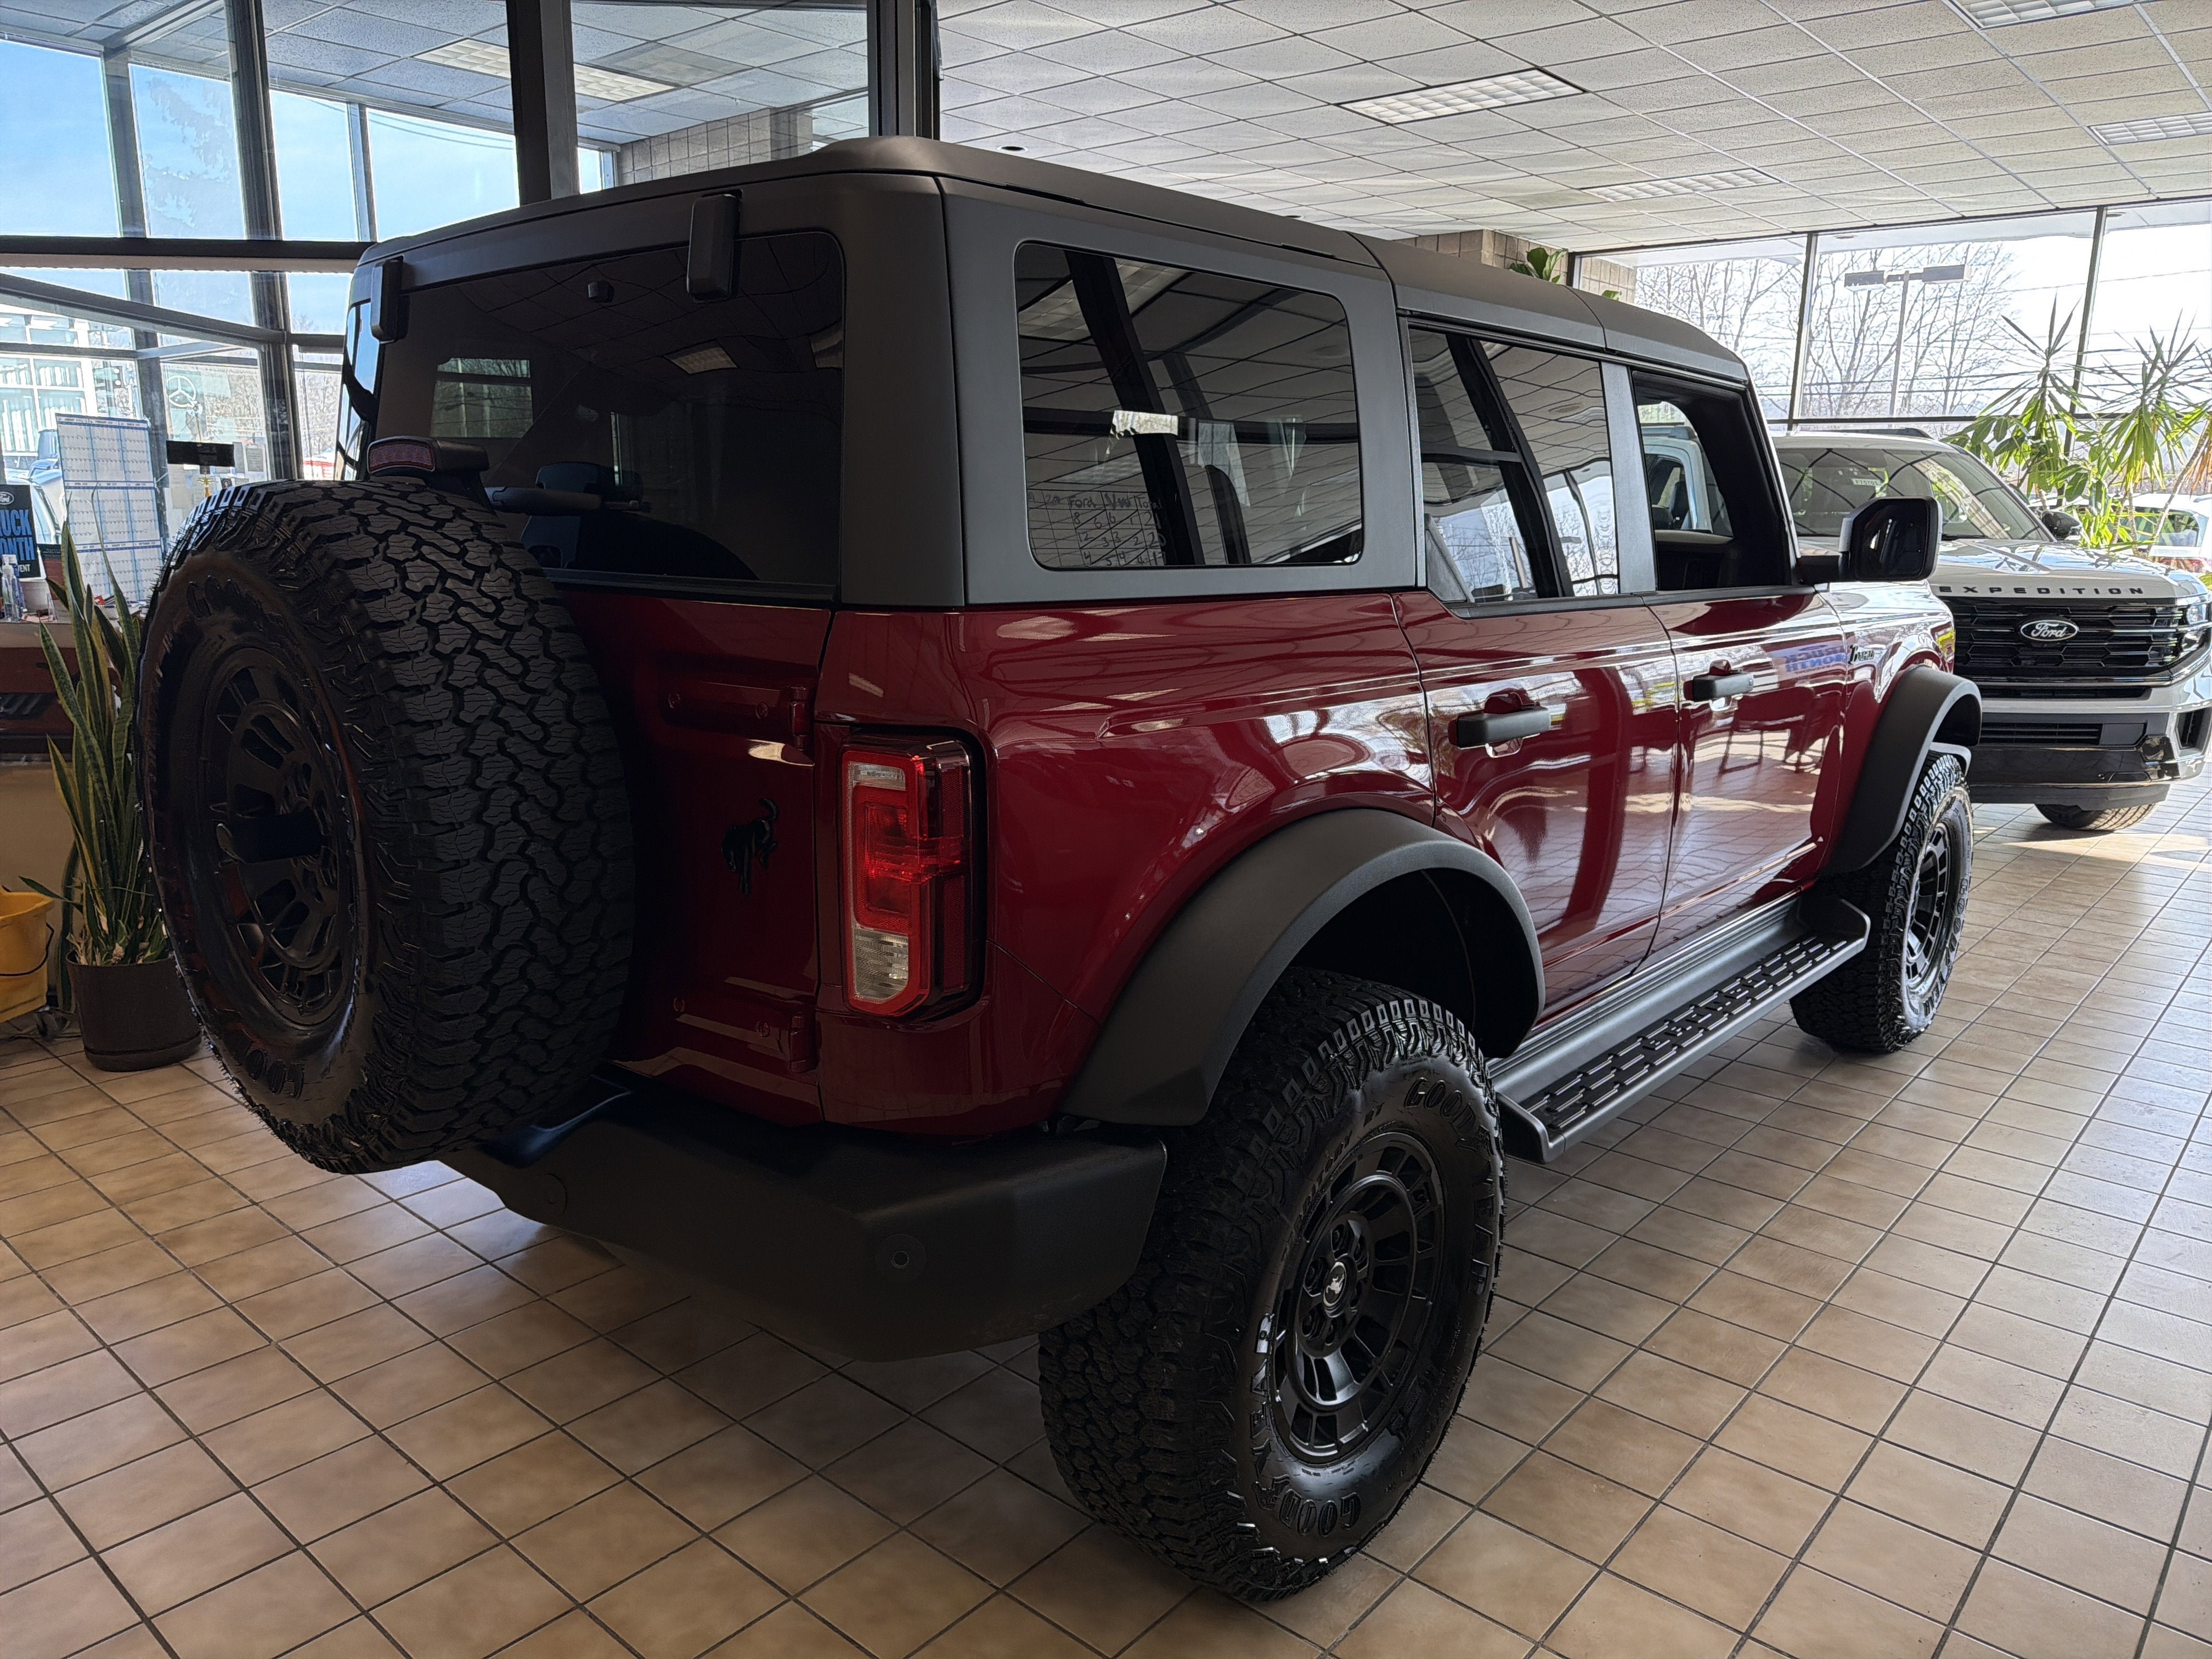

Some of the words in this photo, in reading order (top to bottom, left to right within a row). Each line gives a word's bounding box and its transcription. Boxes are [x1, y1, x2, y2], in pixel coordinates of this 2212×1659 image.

[1069, 495, 1097, 508] Ford
[0, 509, 32, 536] UCK
[1094, 517, 1102, 529] 6
[0, 537, 35, 561] ONTH
[1939, 585, 2143, 595] EXPEDITION
[2030, 621, 2073, 639] Ford
[1403, 1076, 1496, 1295] GOODYEAR
